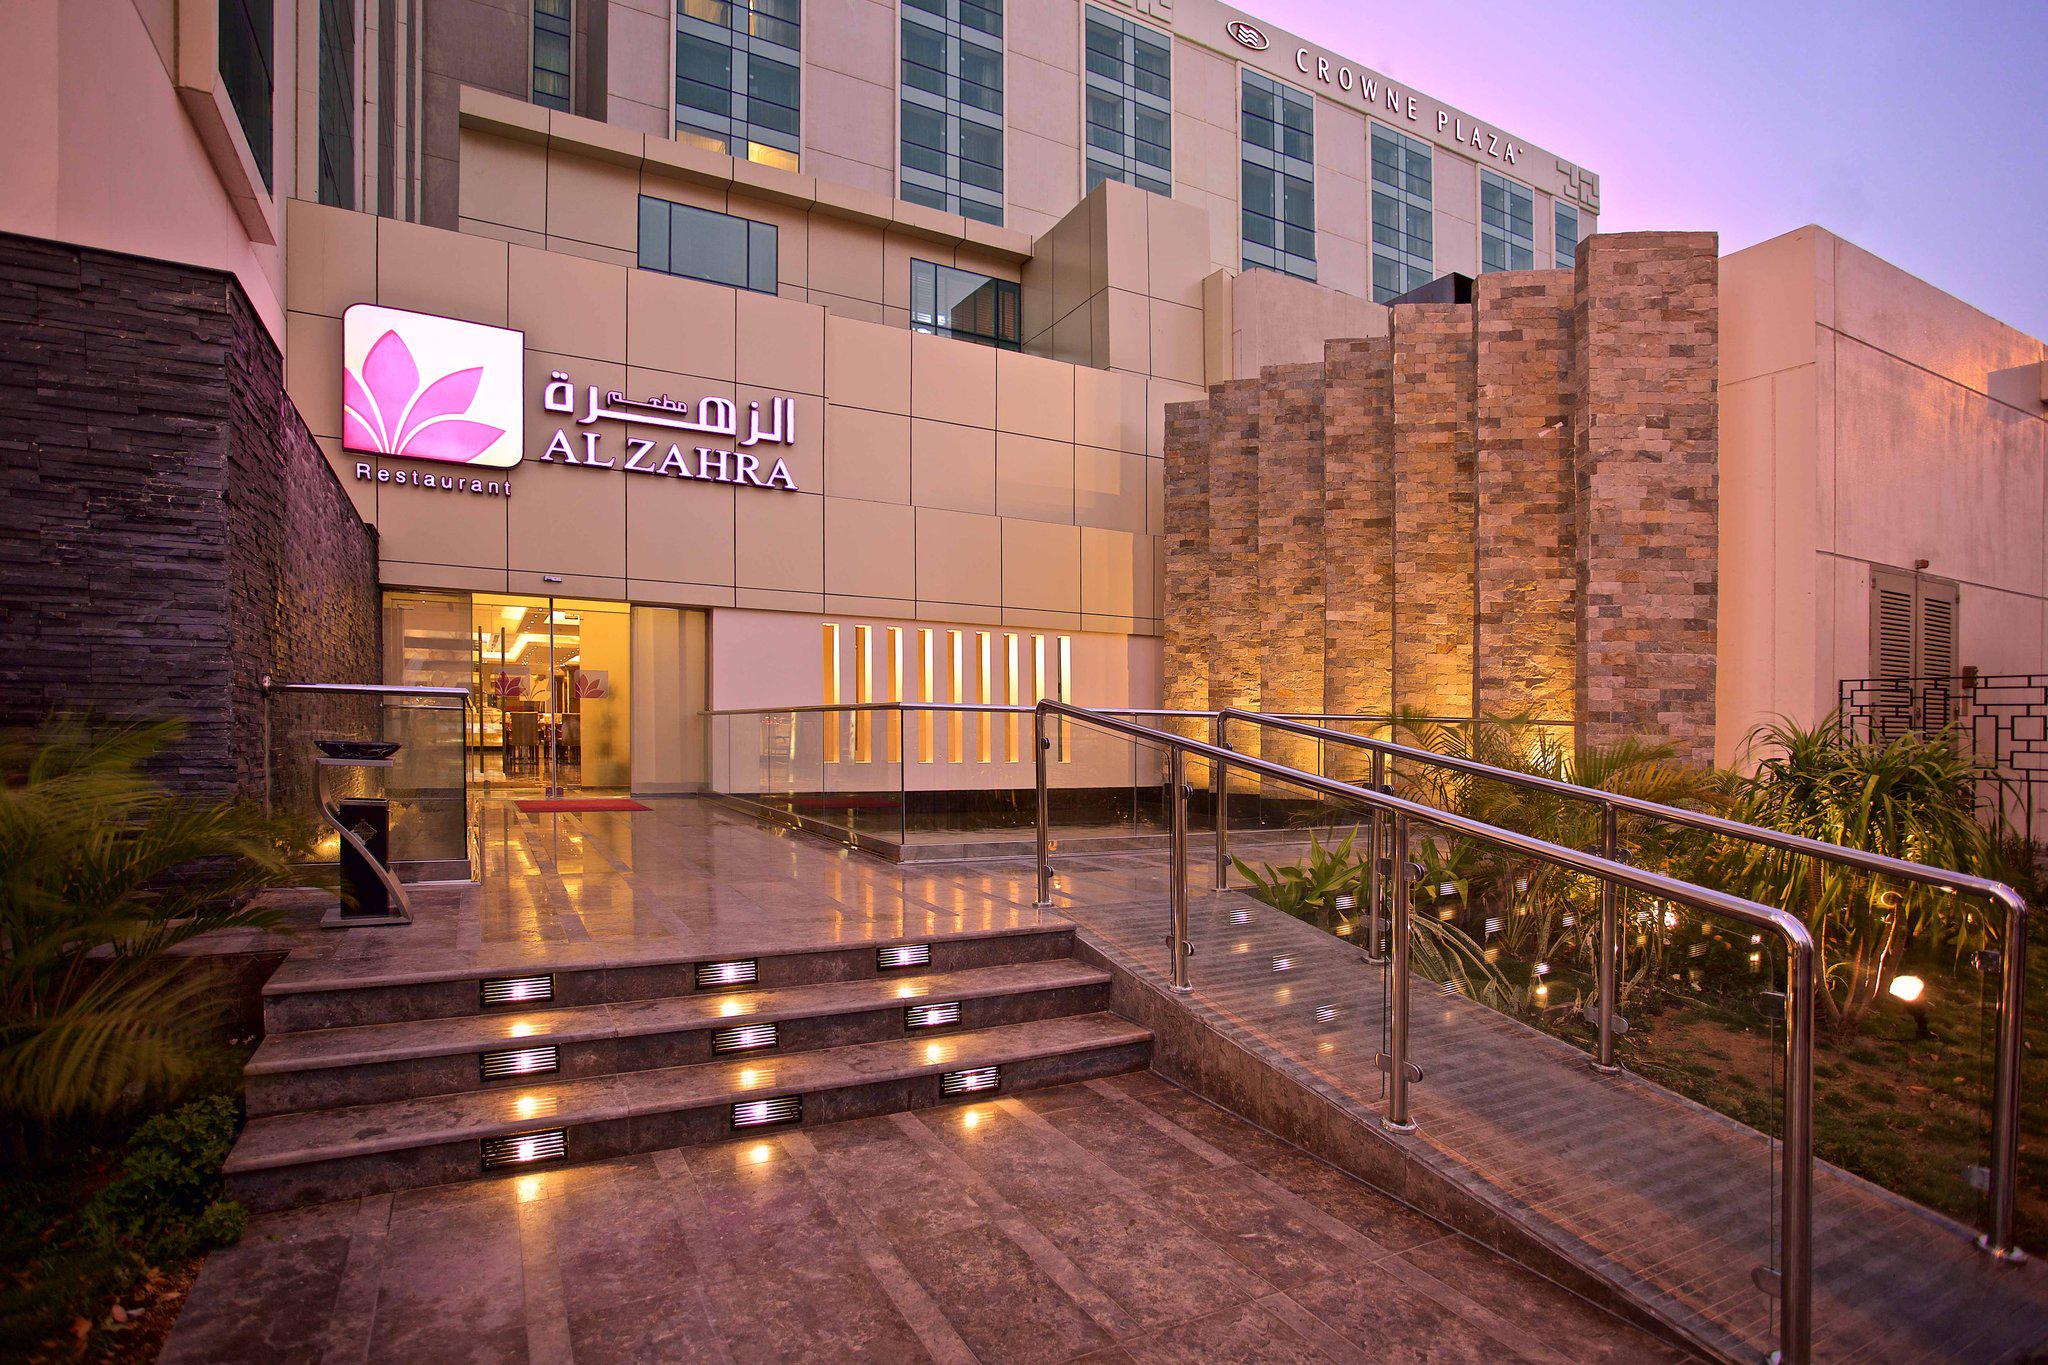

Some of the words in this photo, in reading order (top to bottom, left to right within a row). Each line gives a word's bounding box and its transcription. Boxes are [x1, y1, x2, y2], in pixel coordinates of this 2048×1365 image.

[1296, 48, 1417, 120] CROWNE
[1437, 110, 1515, 164] PLAZA
[544, 370, 795, 446] الزهرة
[356, 462, 512, 496] Restaurant
[540, 428, 615, 467] AL
[623, 438, 798, 490] ZAHRA
